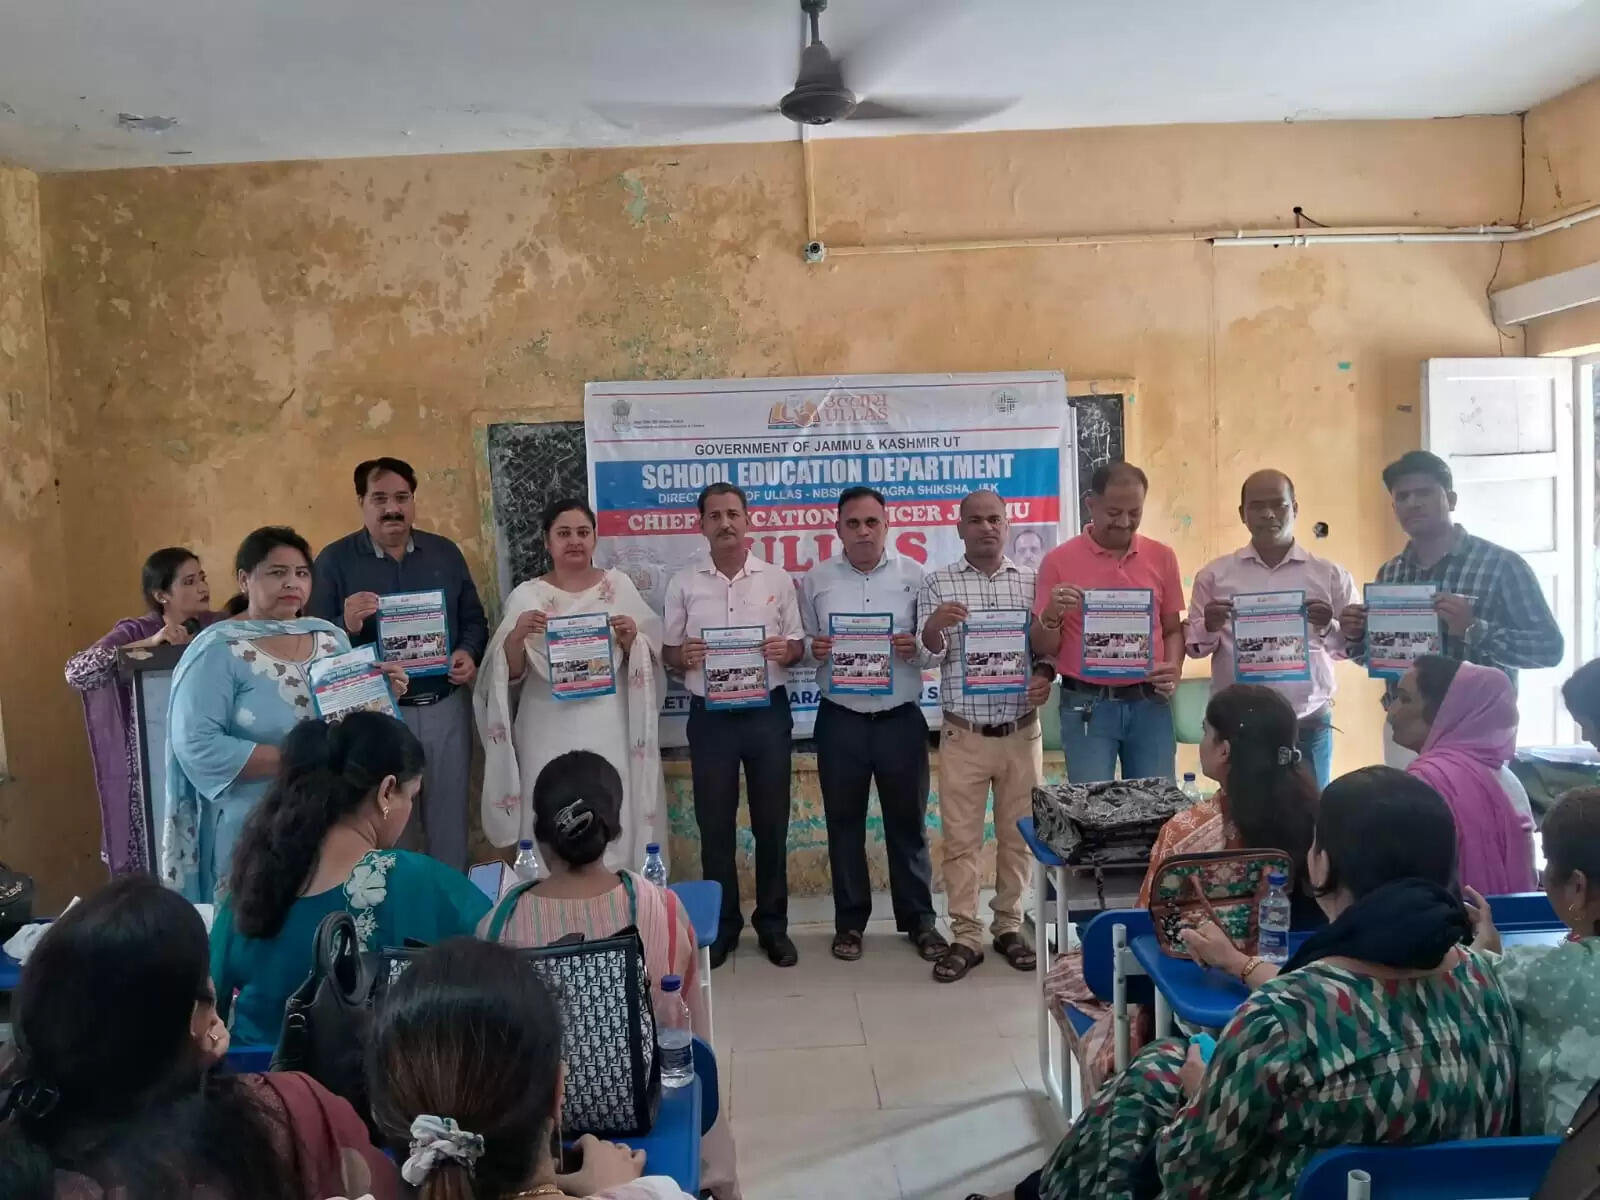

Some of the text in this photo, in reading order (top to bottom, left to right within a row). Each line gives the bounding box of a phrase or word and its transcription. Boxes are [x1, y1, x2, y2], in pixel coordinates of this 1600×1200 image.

[824, 407, 889, 421] ULLAS
[694, 436, 961, 456] GOVERNMENT OF JAMMU & KASHMIR UT
[641, 453, 1015, 490] SCHOOL EDUCATION DEPARTMENT
[658, 492, 702, 504] DIRECT
[744, 490, 761, 501] OF
[764, 488, 803, 500] ULLAS
[628, 512, 698, 531] CHIEF
[747, 507, 839, 528] CATION
[885, 503, 941, 522] ICER
